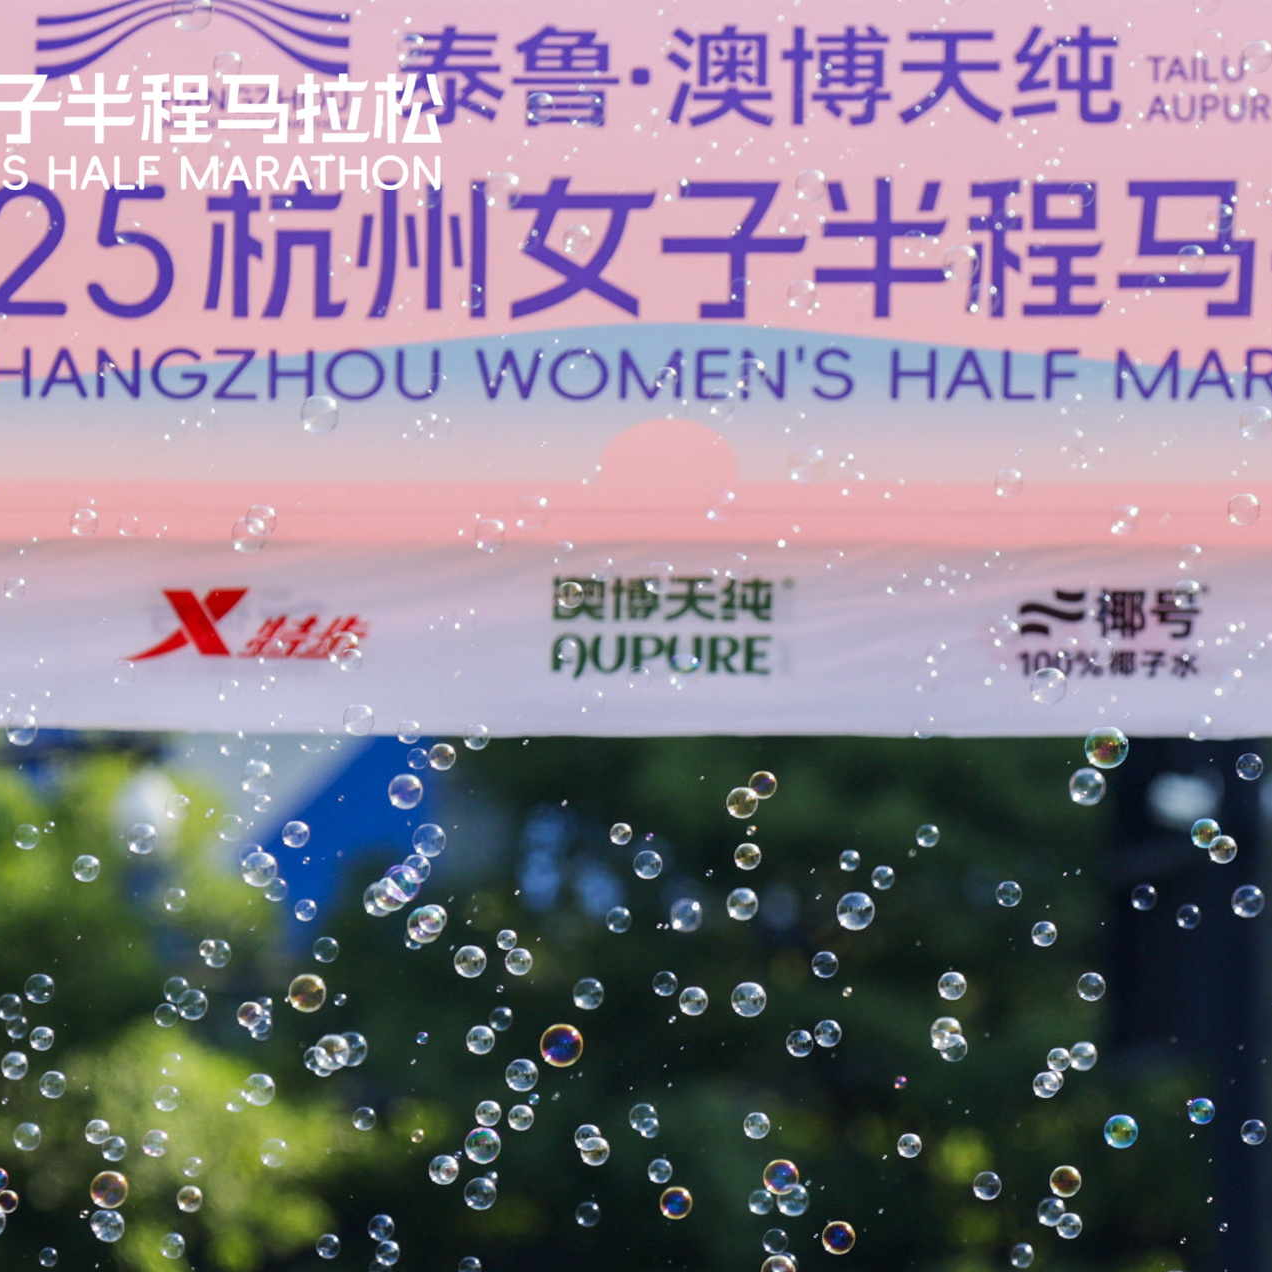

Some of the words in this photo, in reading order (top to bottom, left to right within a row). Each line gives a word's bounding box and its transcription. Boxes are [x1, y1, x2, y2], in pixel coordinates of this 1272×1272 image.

[400, 23, 1123, 128] 泰鲁·澳博天纯
[1147, 55, 1245, 83] TAILU
[475, 346, 855, 401] WOMEN'S
[889, 348, 1079, 400] HALF
[552, 577, 774, 622] 澳博天纯
[550, 632, 773, 680] AUPURE
